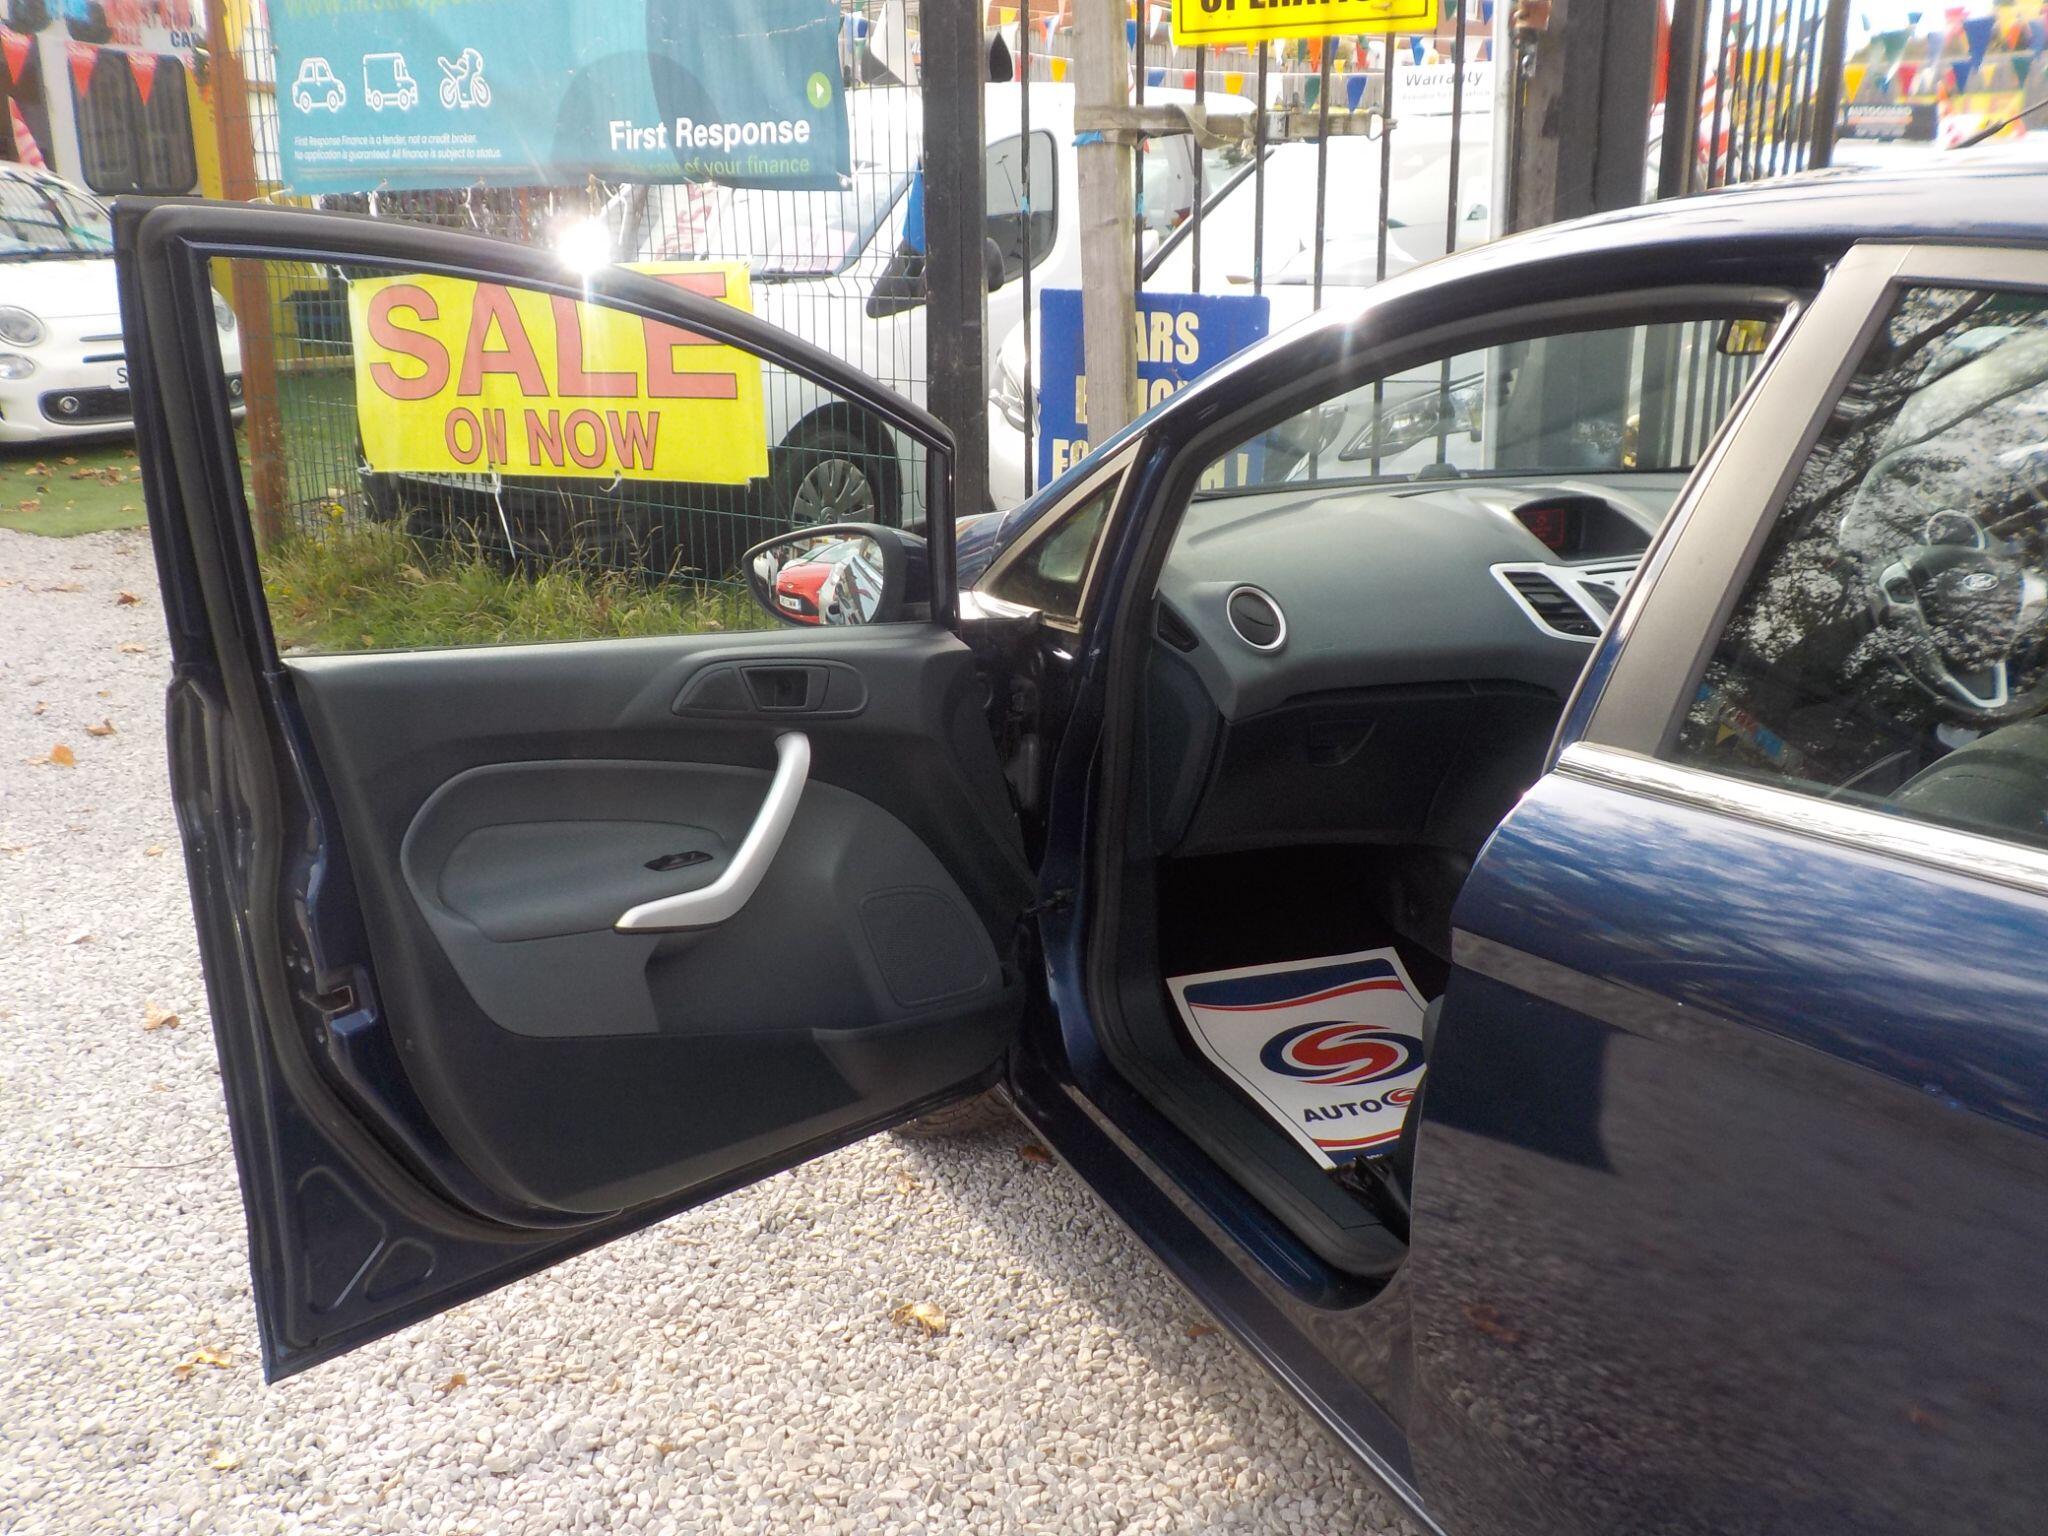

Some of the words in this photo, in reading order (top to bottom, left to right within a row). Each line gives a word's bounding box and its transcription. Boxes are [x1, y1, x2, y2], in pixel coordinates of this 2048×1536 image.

[1406, 71, 1483, 87] Warraty
[608, 120, 668, 151] First
[675, 117, 811, 153] Response
[703, 159, 742, 179] your
[747, 156, 810, 174] finance
[367, 272, 738, 400] SALE
[1135, 311, 1200, 365] ARS
[524, 409, 660, 470] NOW
